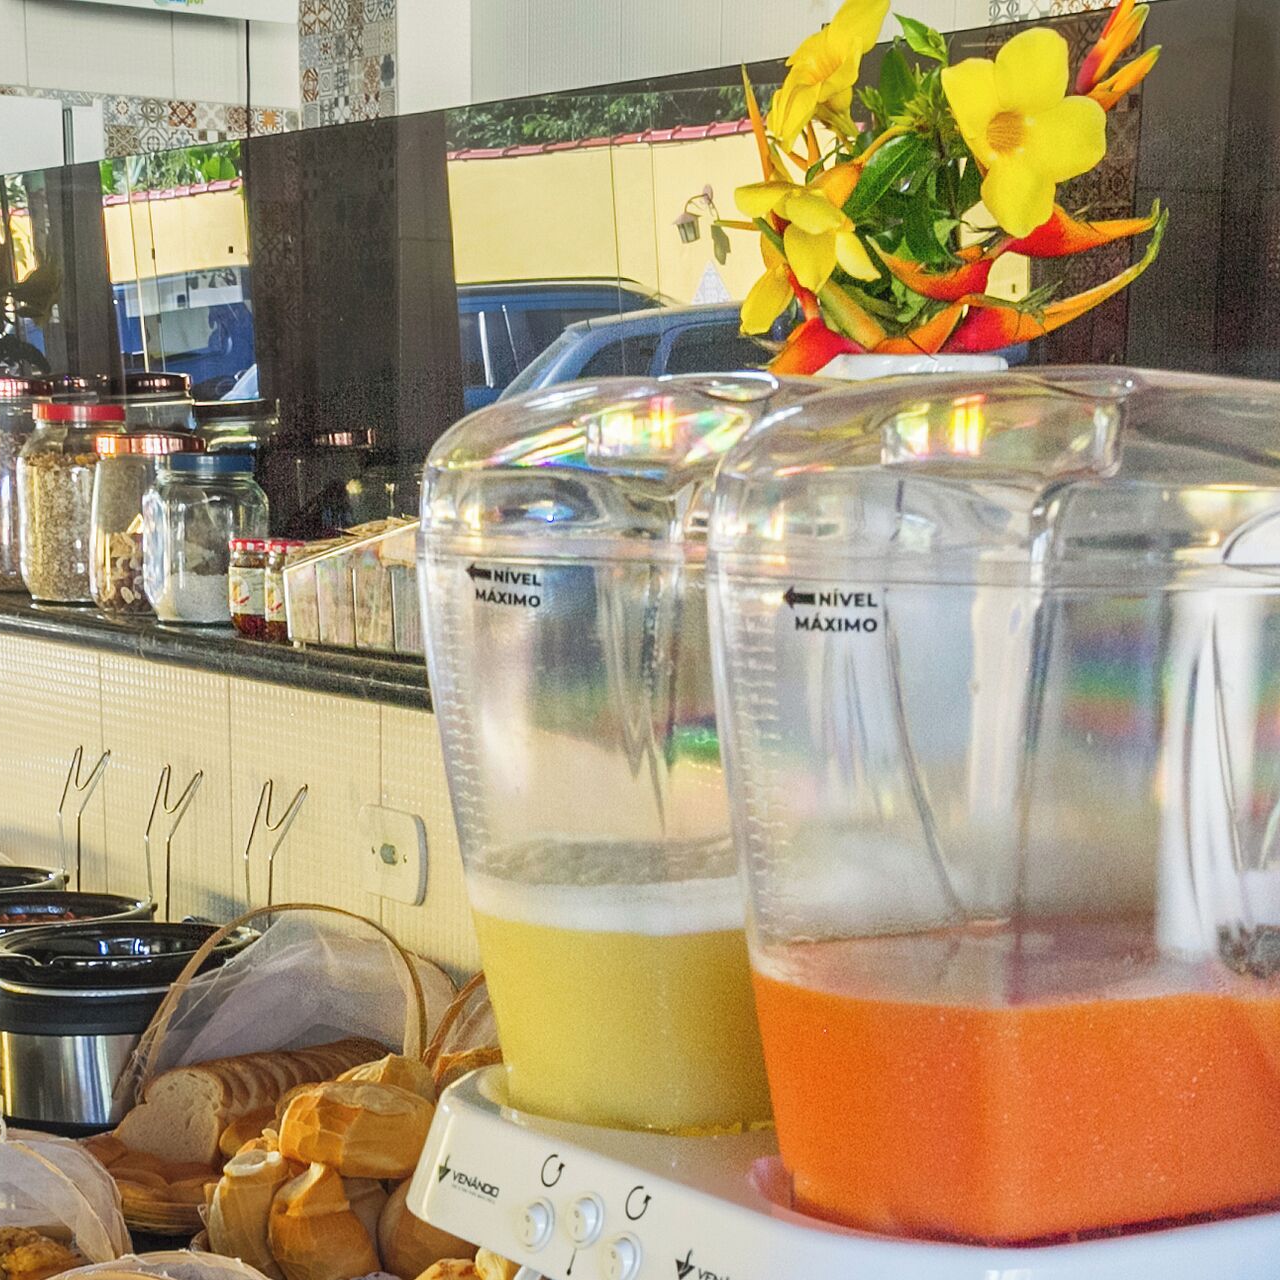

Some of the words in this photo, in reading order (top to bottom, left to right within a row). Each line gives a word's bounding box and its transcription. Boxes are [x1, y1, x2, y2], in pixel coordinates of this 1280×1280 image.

[493, 568, 542, 586] NÍVEL
[475, 587, 541, 608] MÁXIMO
[819, 588, 878, 608] NÍVEL
[795, 612, 878, 633] MÁXIMO
